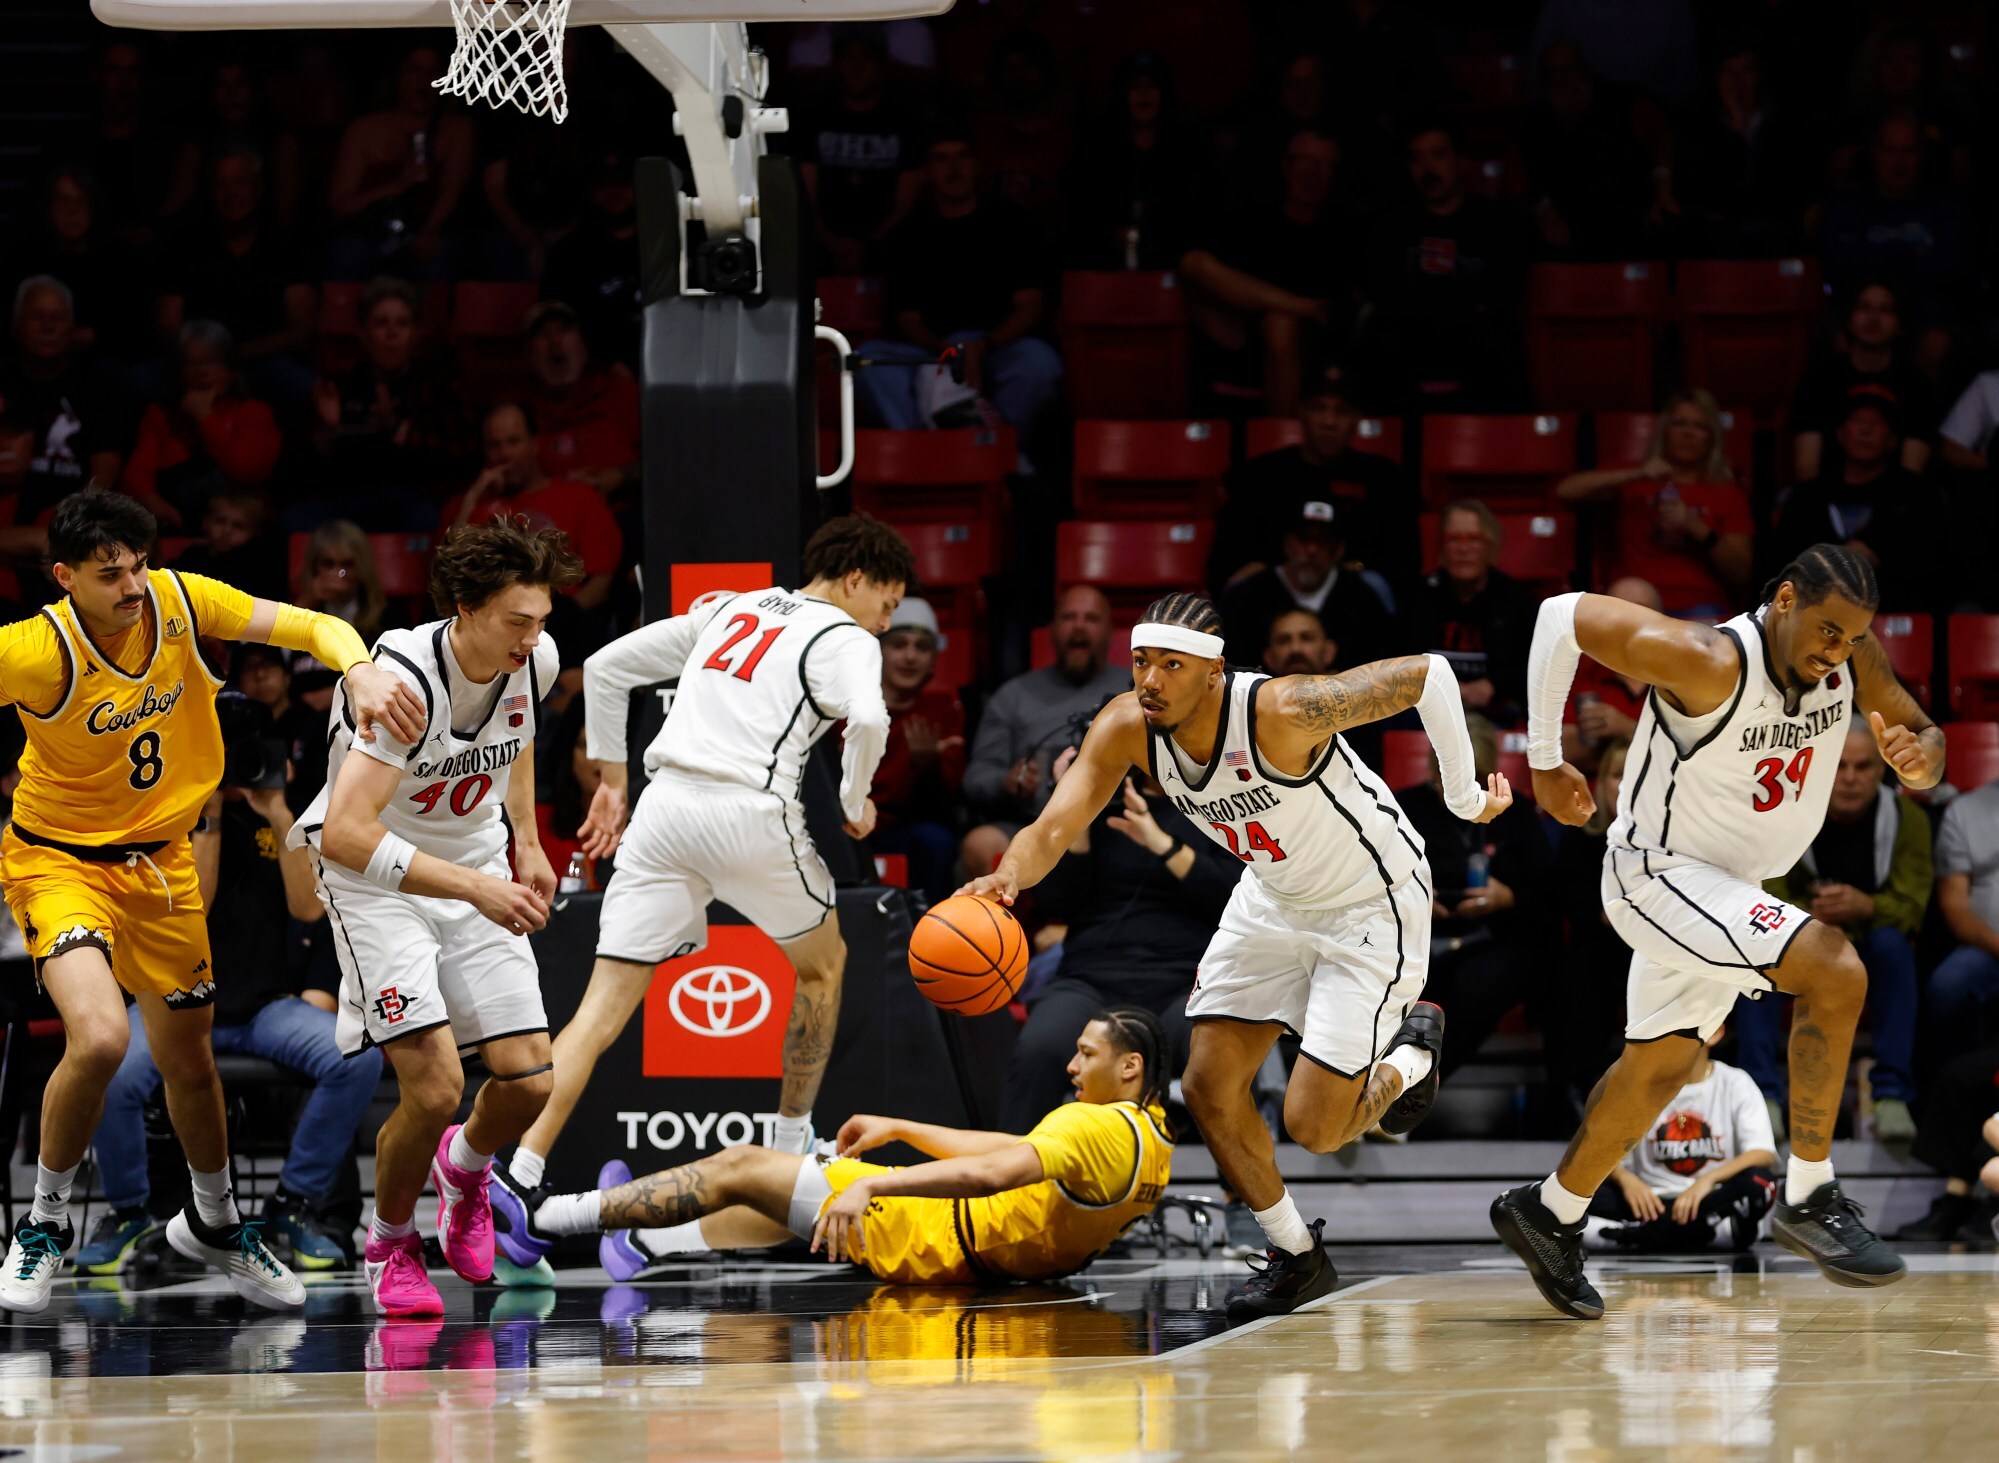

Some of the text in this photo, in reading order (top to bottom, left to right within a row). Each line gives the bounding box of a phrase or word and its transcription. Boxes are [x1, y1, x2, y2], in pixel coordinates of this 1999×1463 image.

[703, 613, 786, 682] 21
[86, 679, 184, 736] Cowboys
[1738, 700, 1843, 752] SAN DIEG STATE
[128, 730, 164, 791] 8
[439, 748, 480, 778] DIEGO
[482, 738, 520, 772] STATE
[1752, 746, 1814, 812] 39
[409, 773, 492, 816] 40
[1169, 794, 1199, 815] AN
[1230, 785, 1281, 818] STATE
[1208, 820, 1287, 862] 24
[617, 1111, 779, 1150] TOYOT
